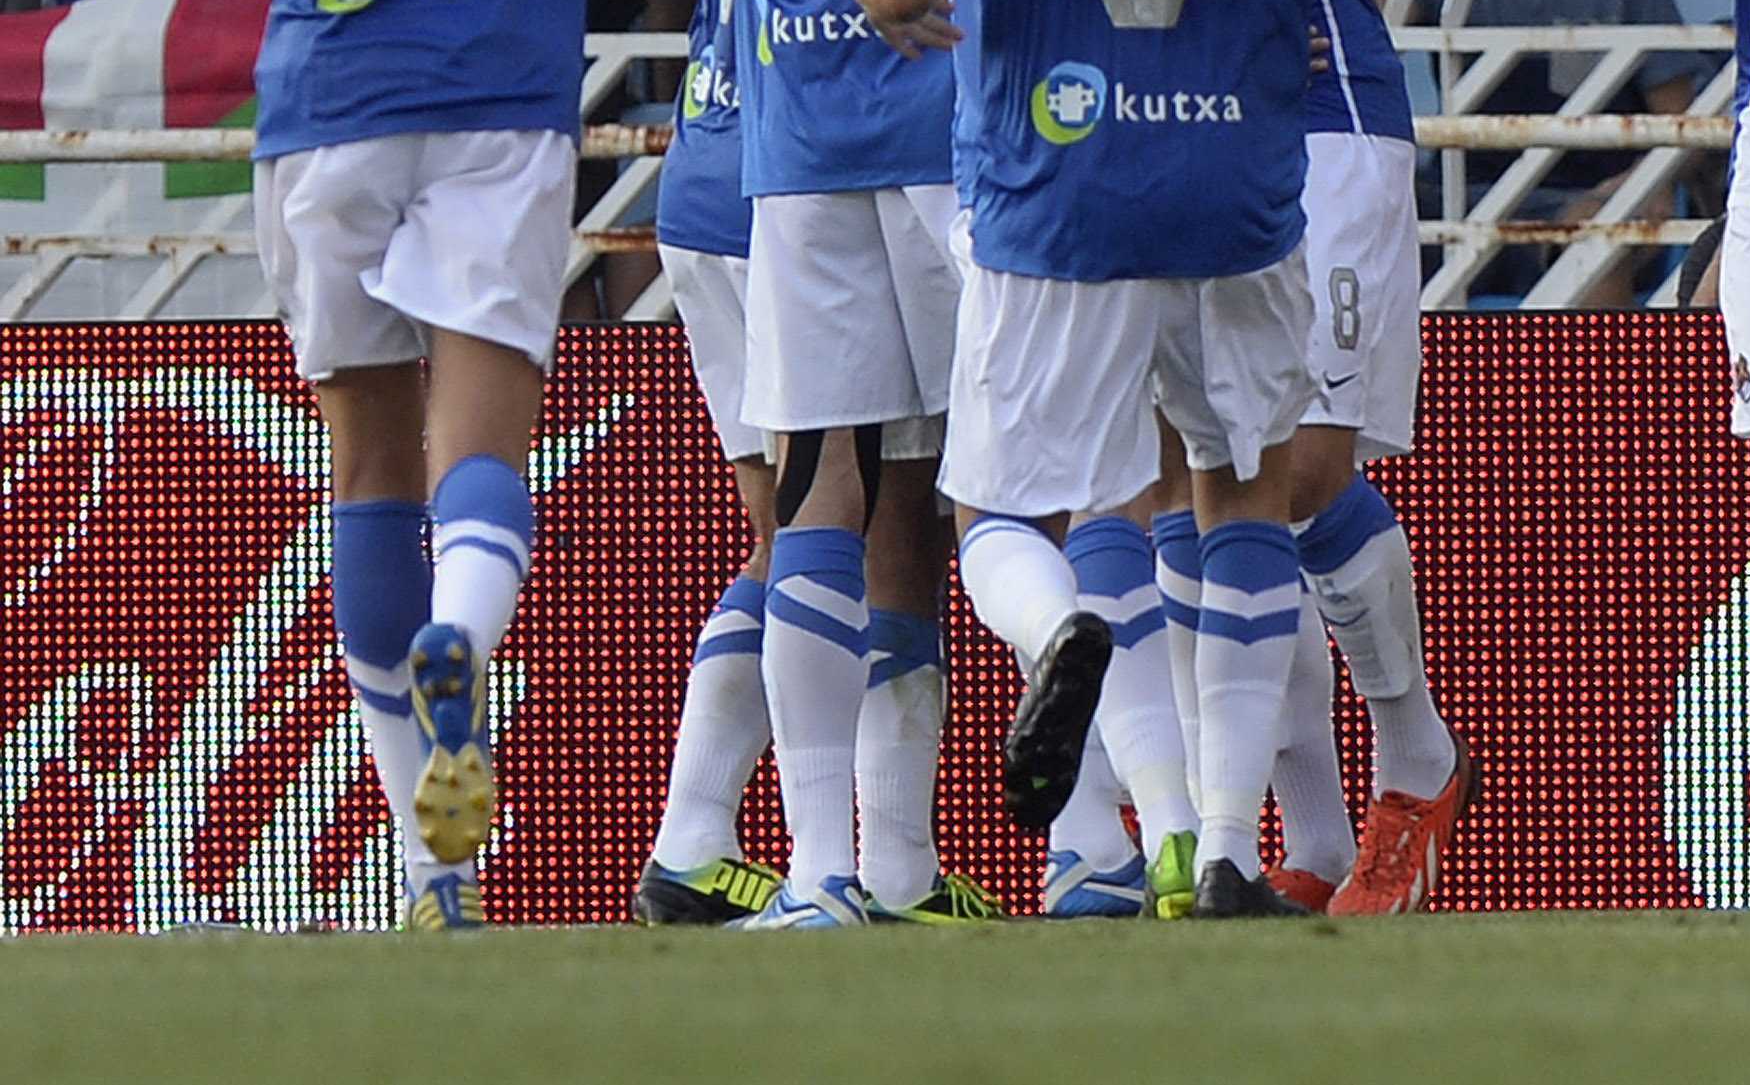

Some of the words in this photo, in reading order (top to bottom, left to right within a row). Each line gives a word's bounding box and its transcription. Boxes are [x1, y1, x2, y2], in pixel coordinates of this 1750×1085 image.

[772, 9, 883, 44] kutx
[1114, 82, 1243, 122] kutxa
[1328, 267, 1361, 351] 8
